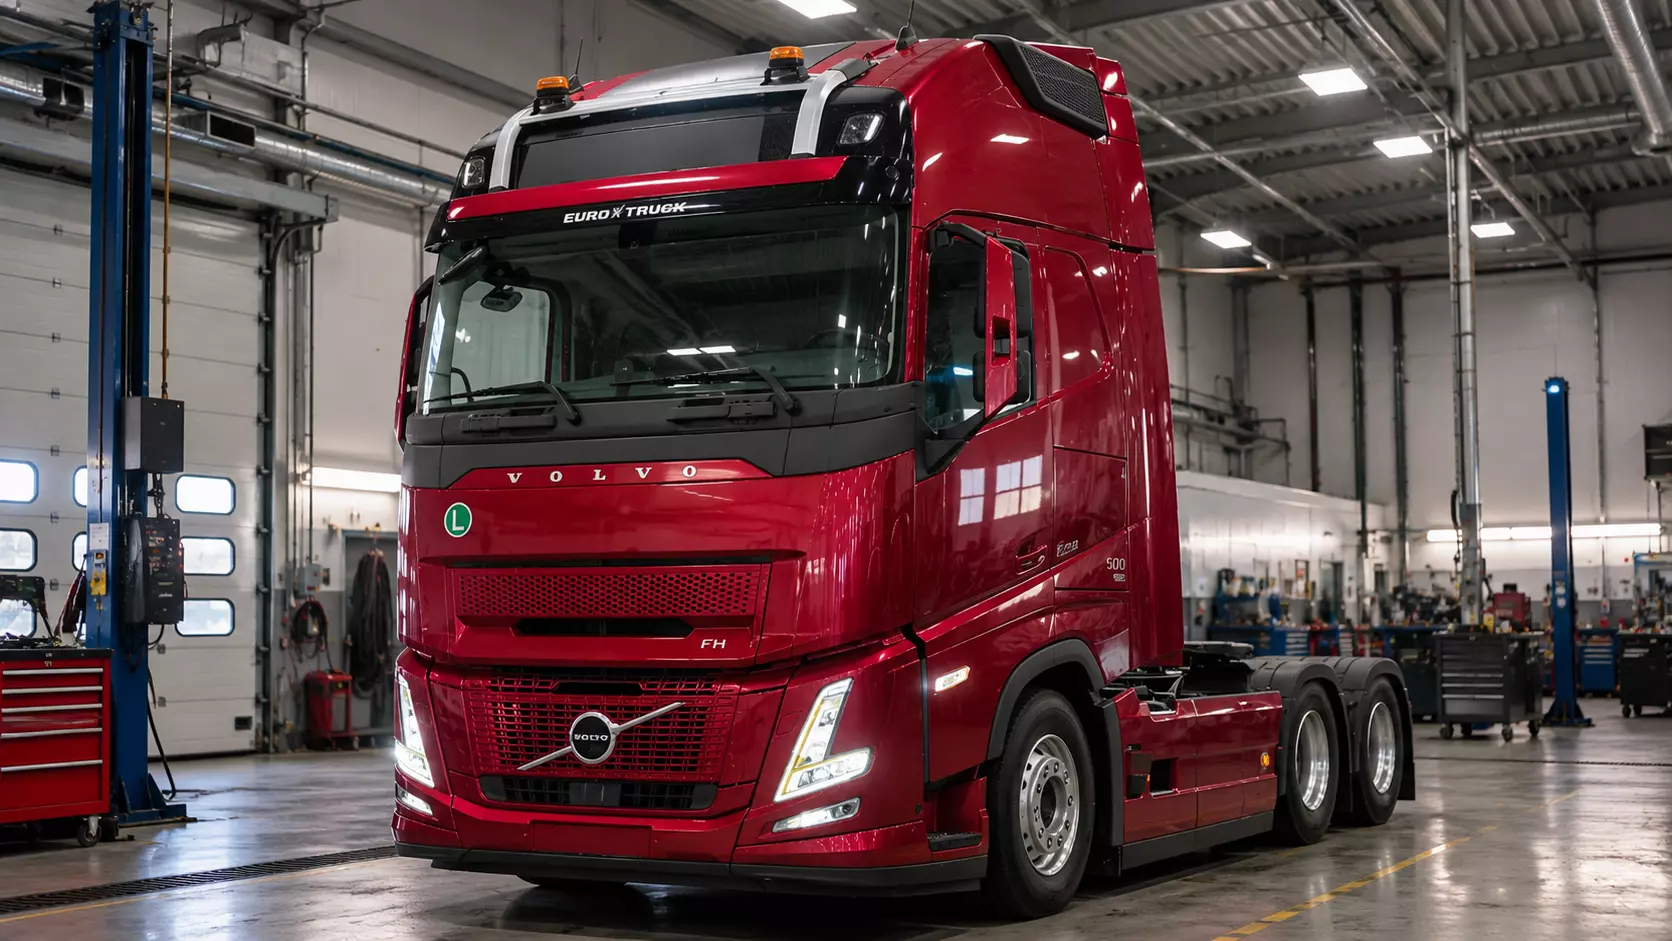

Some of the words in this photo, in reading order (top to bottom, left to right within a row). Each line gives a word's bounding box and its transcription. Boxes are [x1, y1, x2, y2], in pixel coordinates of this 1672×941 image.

[507, 465, 698, 484] VOLVO
[451, 509, 465, 531] L
[1106, 557, 1126, 571] 500
[700, 638, 727, 649] FH
